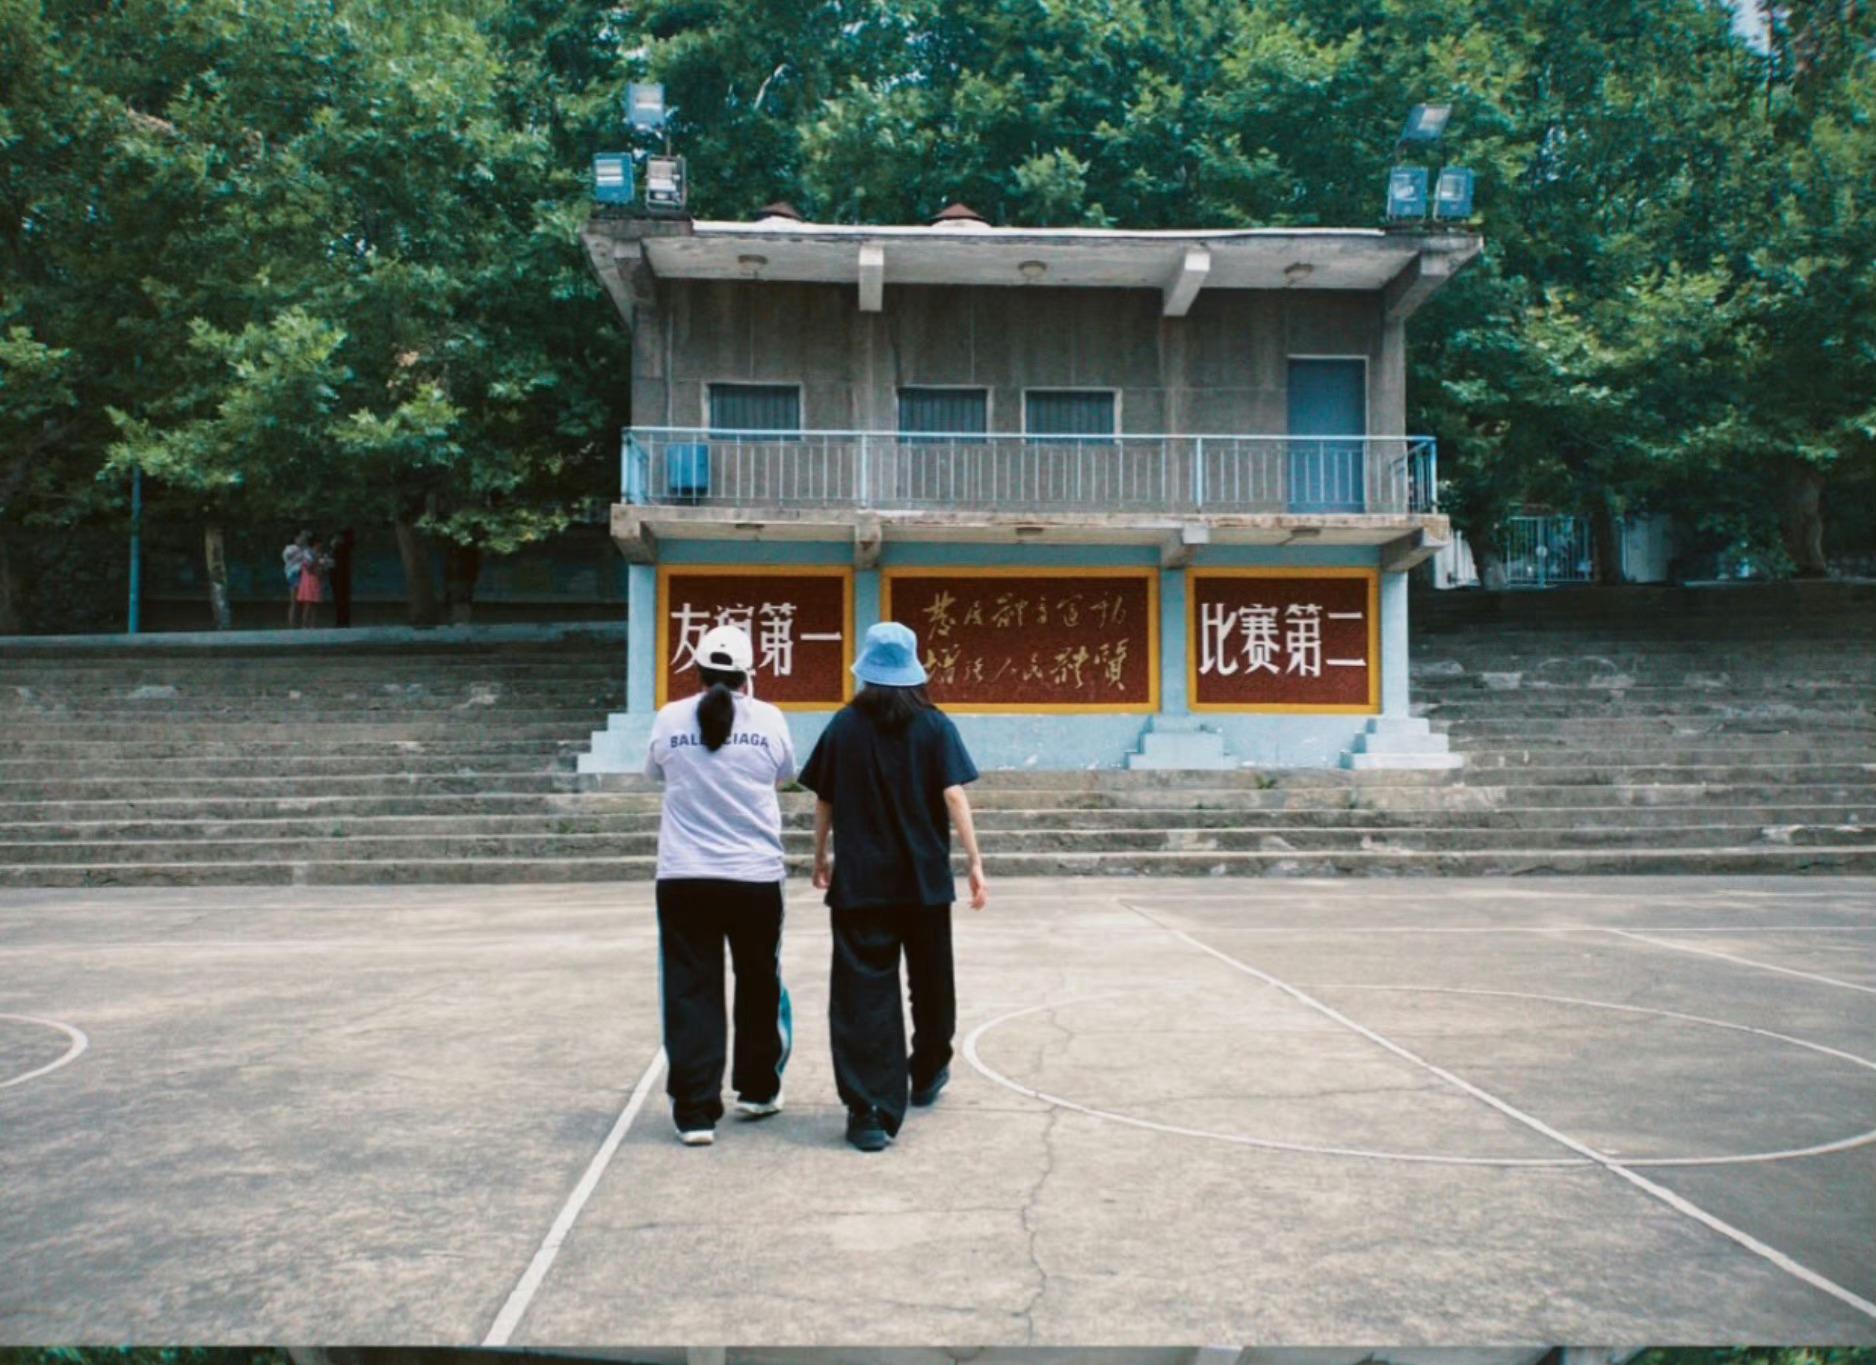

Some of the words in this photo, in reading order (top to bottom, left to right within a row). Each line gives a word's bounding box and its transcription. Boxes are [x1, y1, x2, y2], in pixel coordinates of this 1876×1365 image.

[1198, 603, 1367, 677] 比赛第二
[670, 733, 769, 748] BALIAGA
